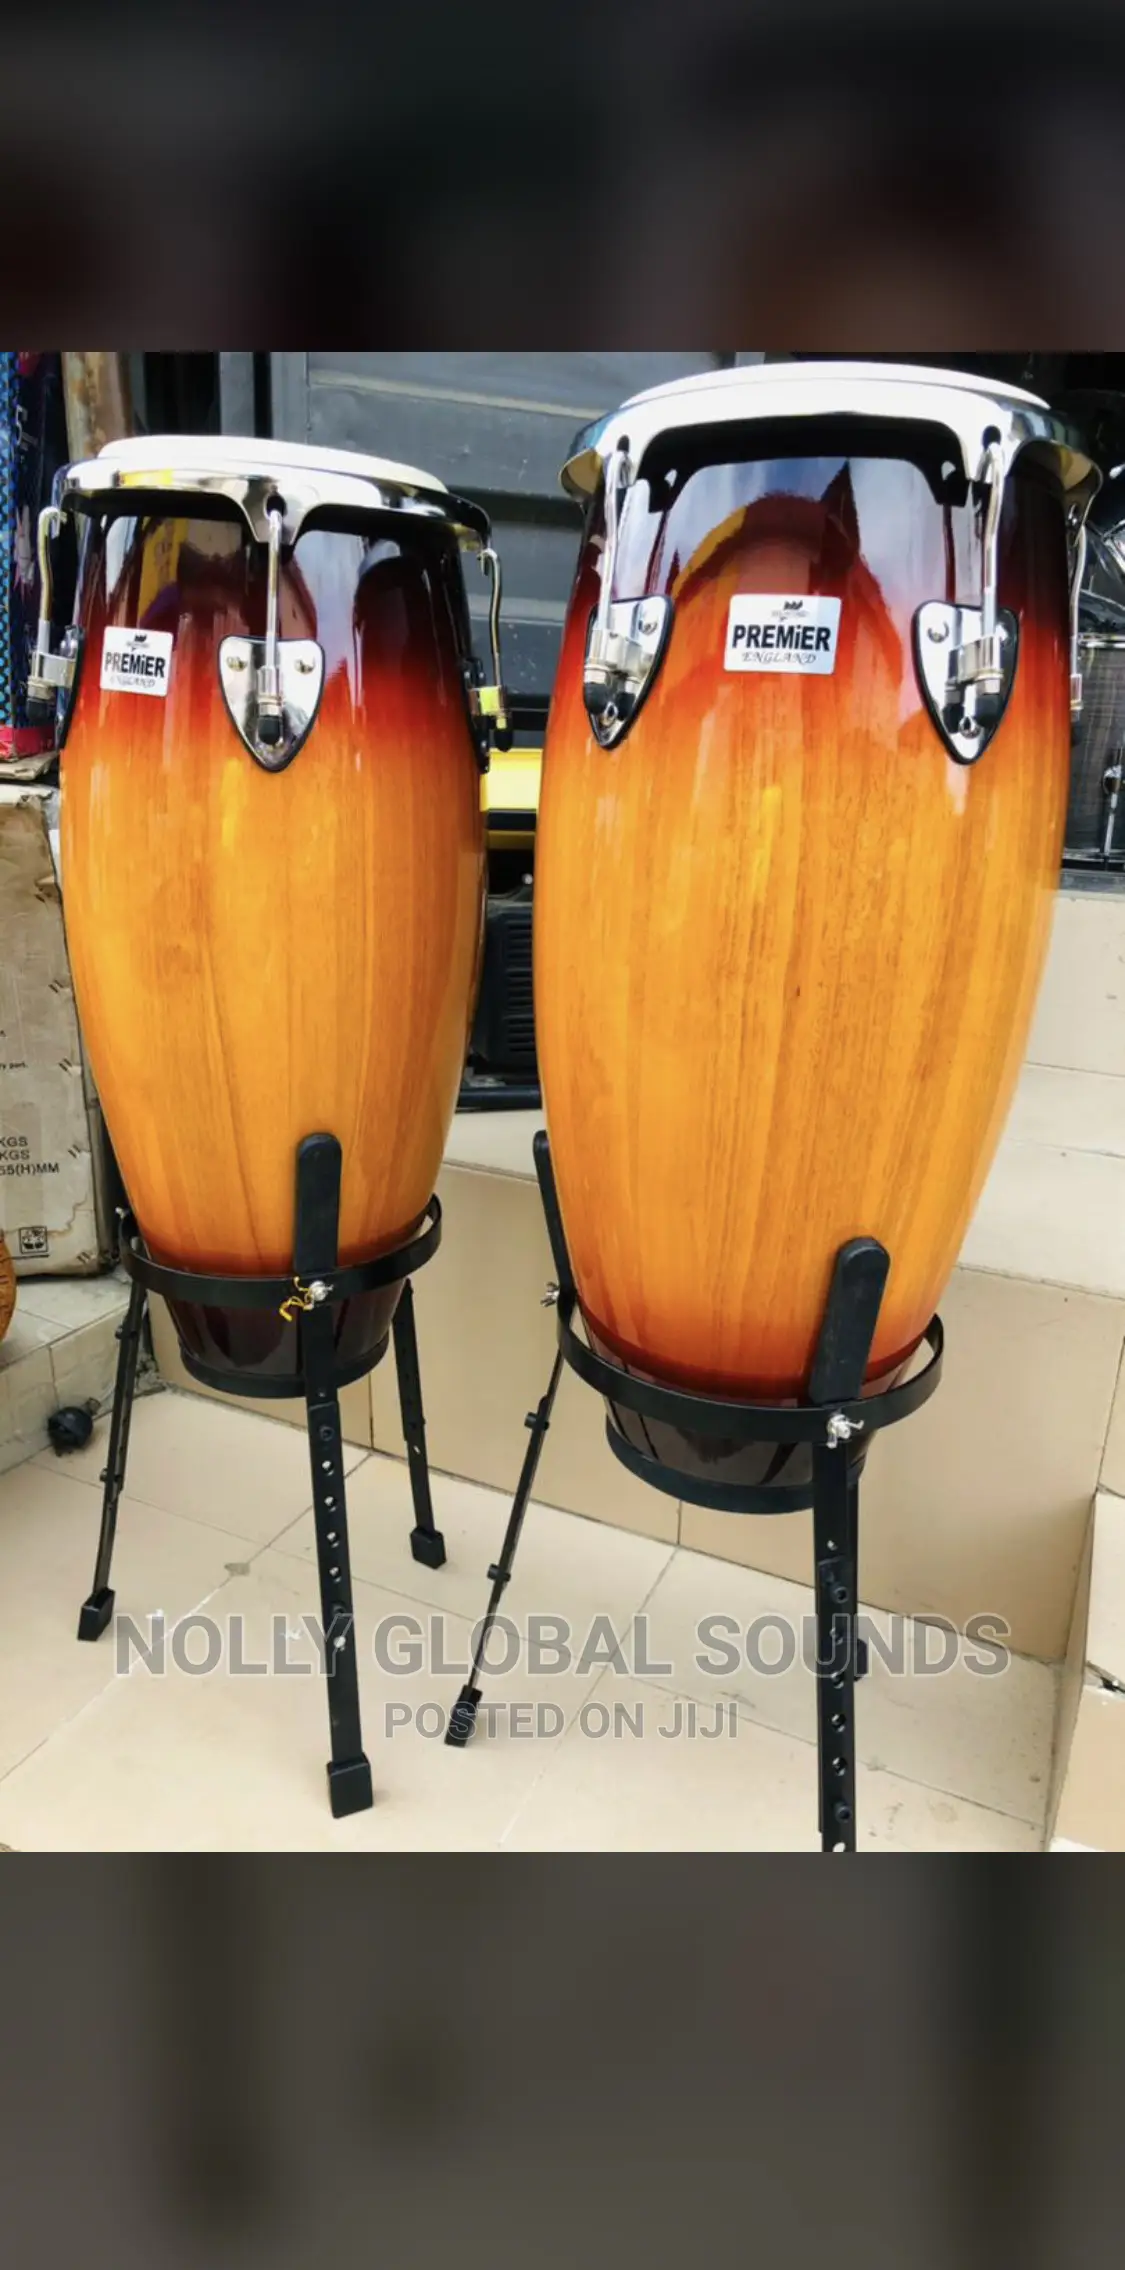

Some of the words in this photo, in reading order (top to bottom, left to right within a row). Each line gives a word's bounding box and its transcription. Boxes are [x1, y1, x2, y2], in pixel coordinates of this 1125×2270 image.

[732, 624, 831, 652] PREMiER
[104, 651, 166, 678] PREMiER
[741, 651, 817, 666] ENGLAND
